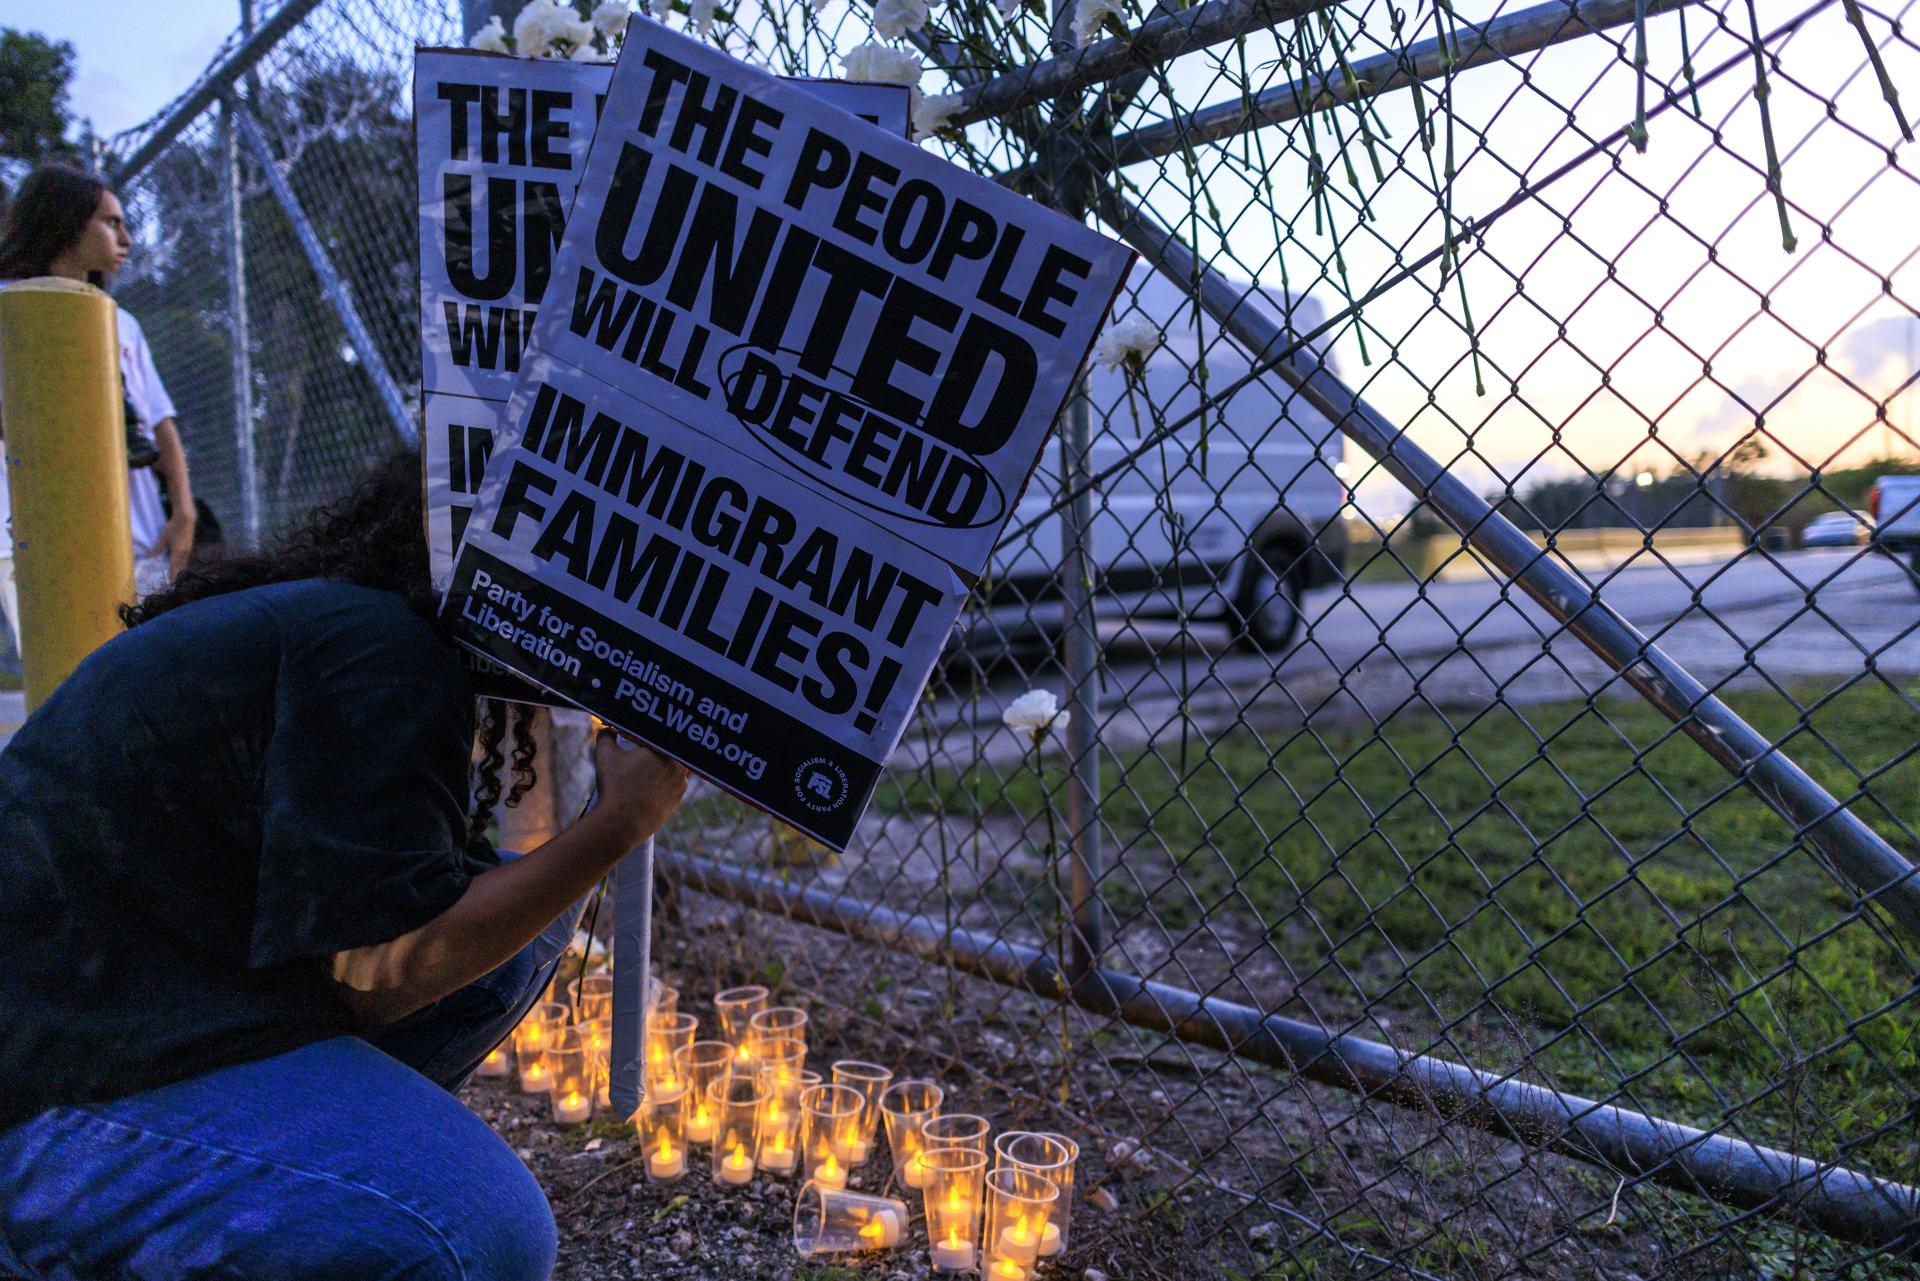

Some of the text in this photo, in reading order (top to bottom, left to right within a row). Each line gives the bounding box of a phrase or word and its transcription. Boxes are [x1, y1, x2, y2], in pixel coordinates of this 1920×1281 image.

[437, 81, 573, 170] THE
[638, 47, 1093, 339] THE PEOPLE
[595, 140, 1038, 456] UNITED
[570, 266, 988, 528] WILL DEFEND
[492, 459, 903, 735] FAMILIES!
[521, 382, 944, 649] IMMIGRANT
[462, 594, 767, 781] Liberation PSLWeb.org
[472, 568, 749, 734] Party for Socialism and
[794, 757, 826, 783] SOCIALISM
[795, 785, 806, 802] FOR
[806, 801, 831, 812] PARTY
[833, 765, 849, 809] LIBERATION
